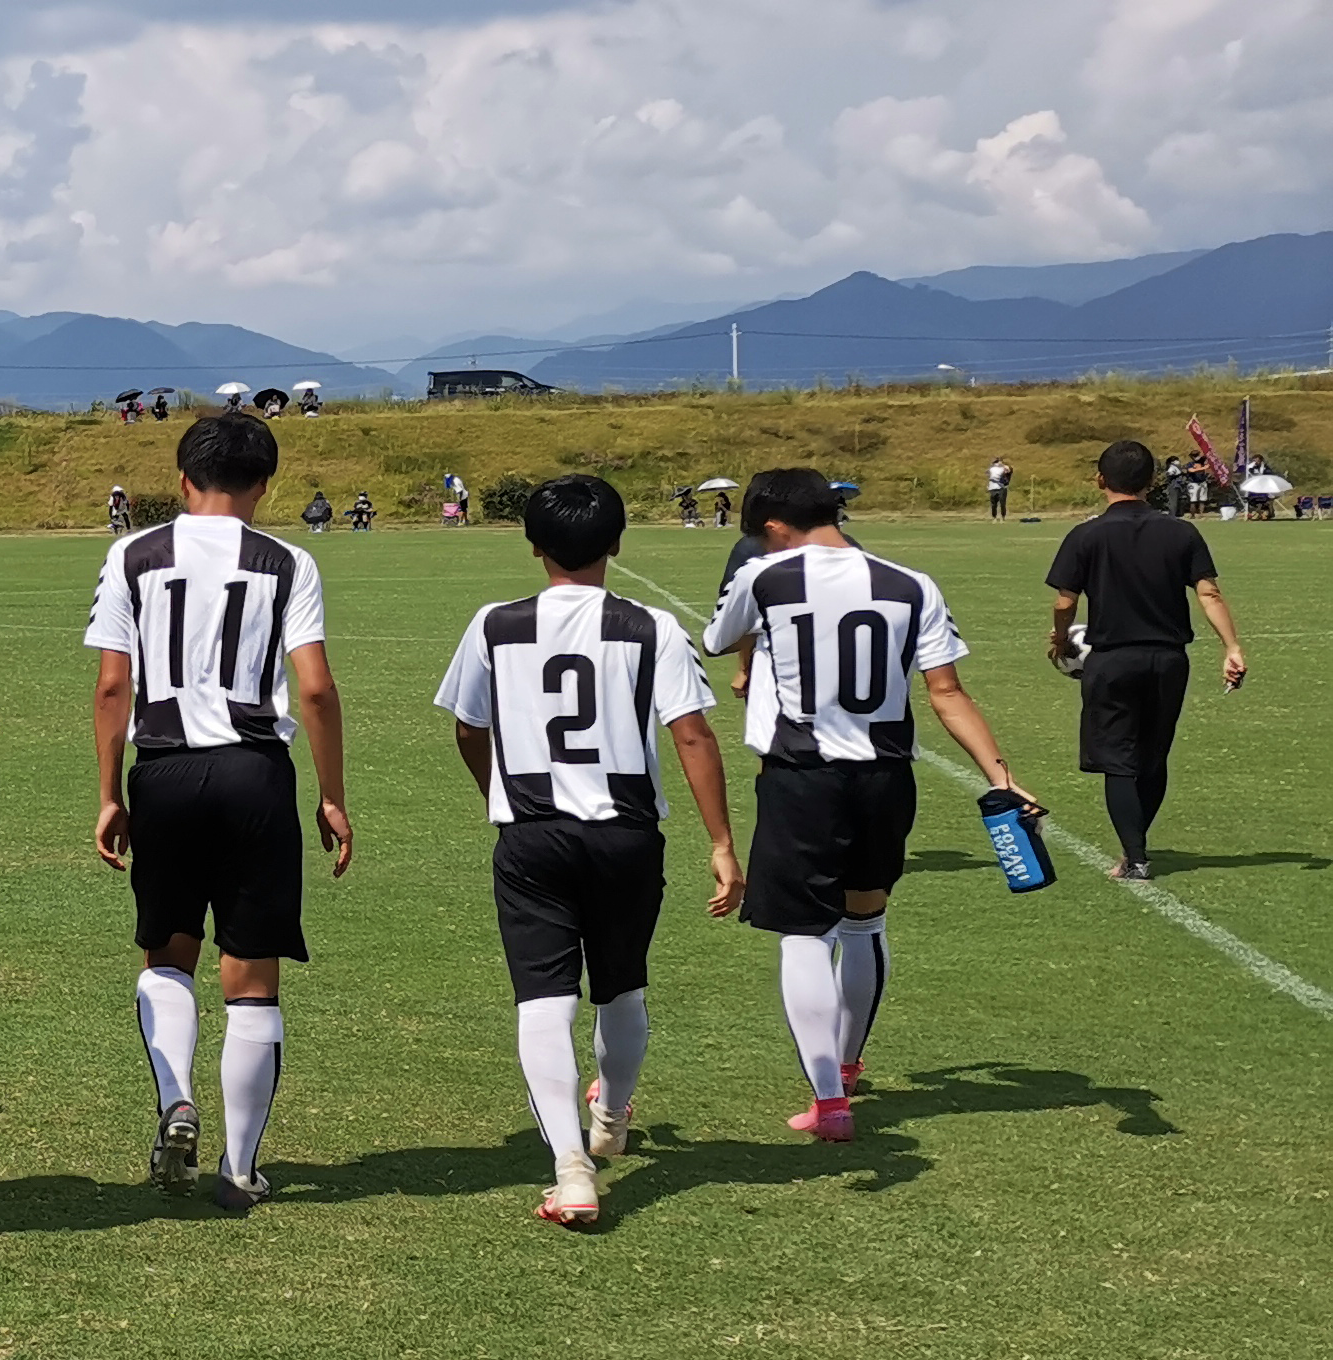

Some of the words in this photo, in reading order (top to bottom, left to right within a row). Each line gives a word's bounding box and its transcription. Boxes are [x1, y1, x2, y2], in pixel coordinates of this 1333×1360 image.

[164, 578, 248, 691] 11
[790, 609, 889, 715] 10
[542, 653, 601, 765] 2
[996, 823, 1030, 881] POCARI
